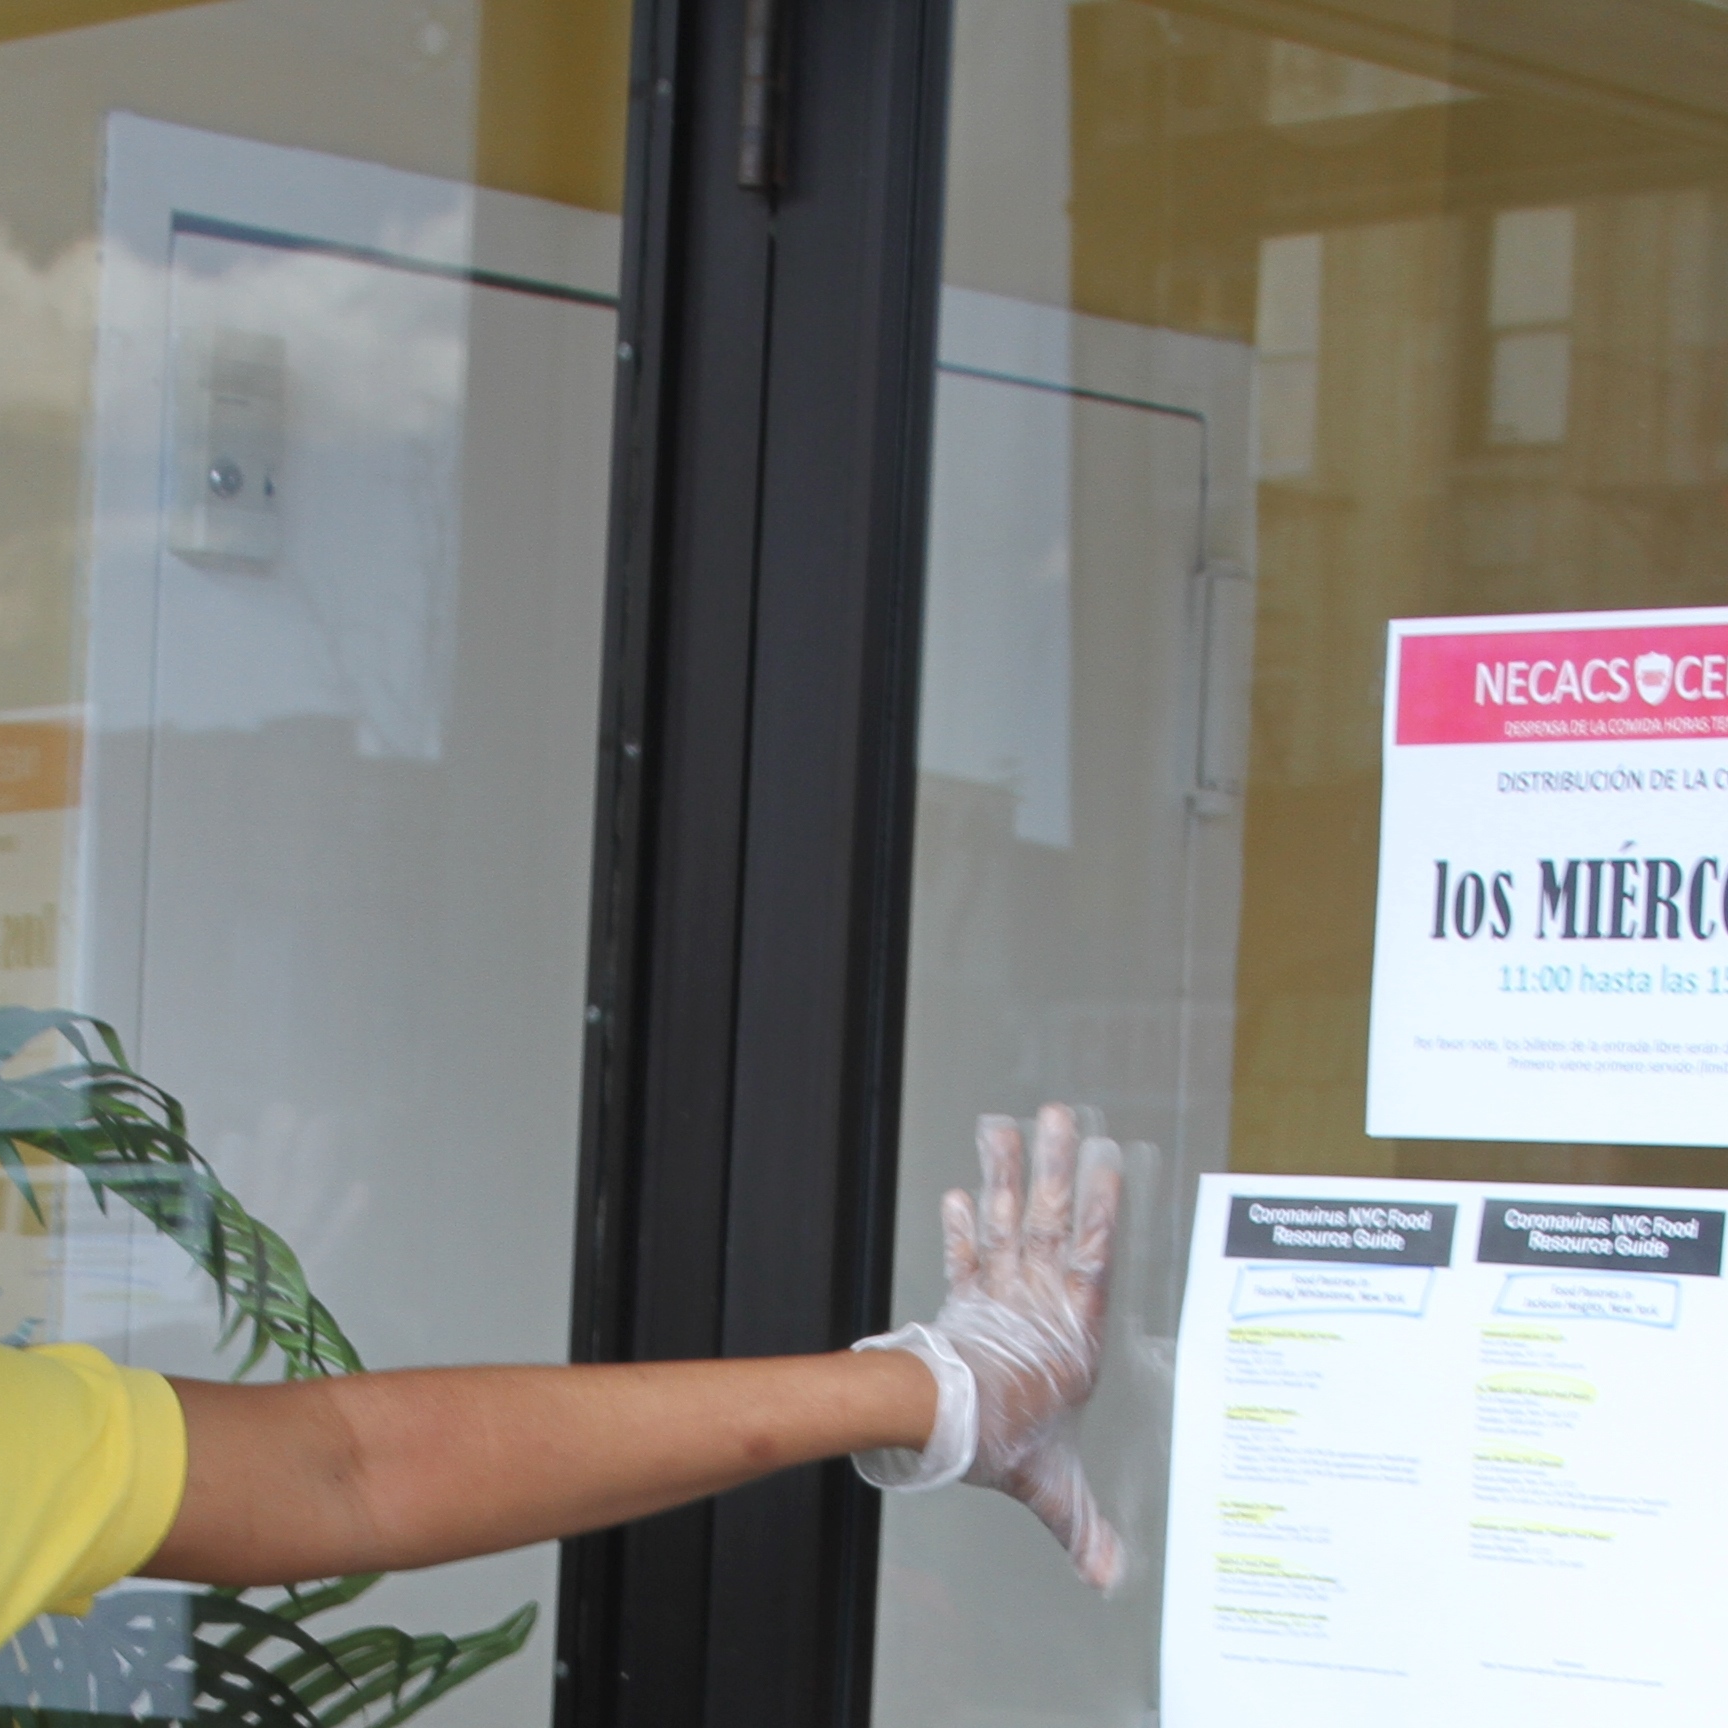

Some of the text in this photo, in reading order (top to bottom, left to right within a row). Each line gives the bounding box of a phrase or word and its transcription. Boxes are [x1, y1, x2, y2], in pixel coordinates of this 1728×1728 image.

[1475, 658, 1631, 706] NECACS
[1504, 720, 1570, 737] DESPENSA
[1570, 719, 1589, 736] DE
[1590, 718, 1608, 735] LA
[1608, 717, 1663, 735] COMIDA
[1664, 716, 1710, 734] HORAS
[1497, 764, 1644, 793] DISTRIBUCIÓN
[1649, 768, 1677, 791] DE
[1683, 767, 1709, 790] LA
[1430, 859, 1515, 941] los
[1499, 964, 1572, 994] 11:00
[1579, 964, 1652, 994] hasta
[1661, 965, 1699, 994] las
[1249, 1203, 1432, 1231] Coronavirus NYC Food
[1504, 1208, 1700, 1239] Coronavirus NYC Food
[1272, 1225, 1406, 1251] Resource Guide
[1528, 1229, 1670, 1258] Resource Guide
